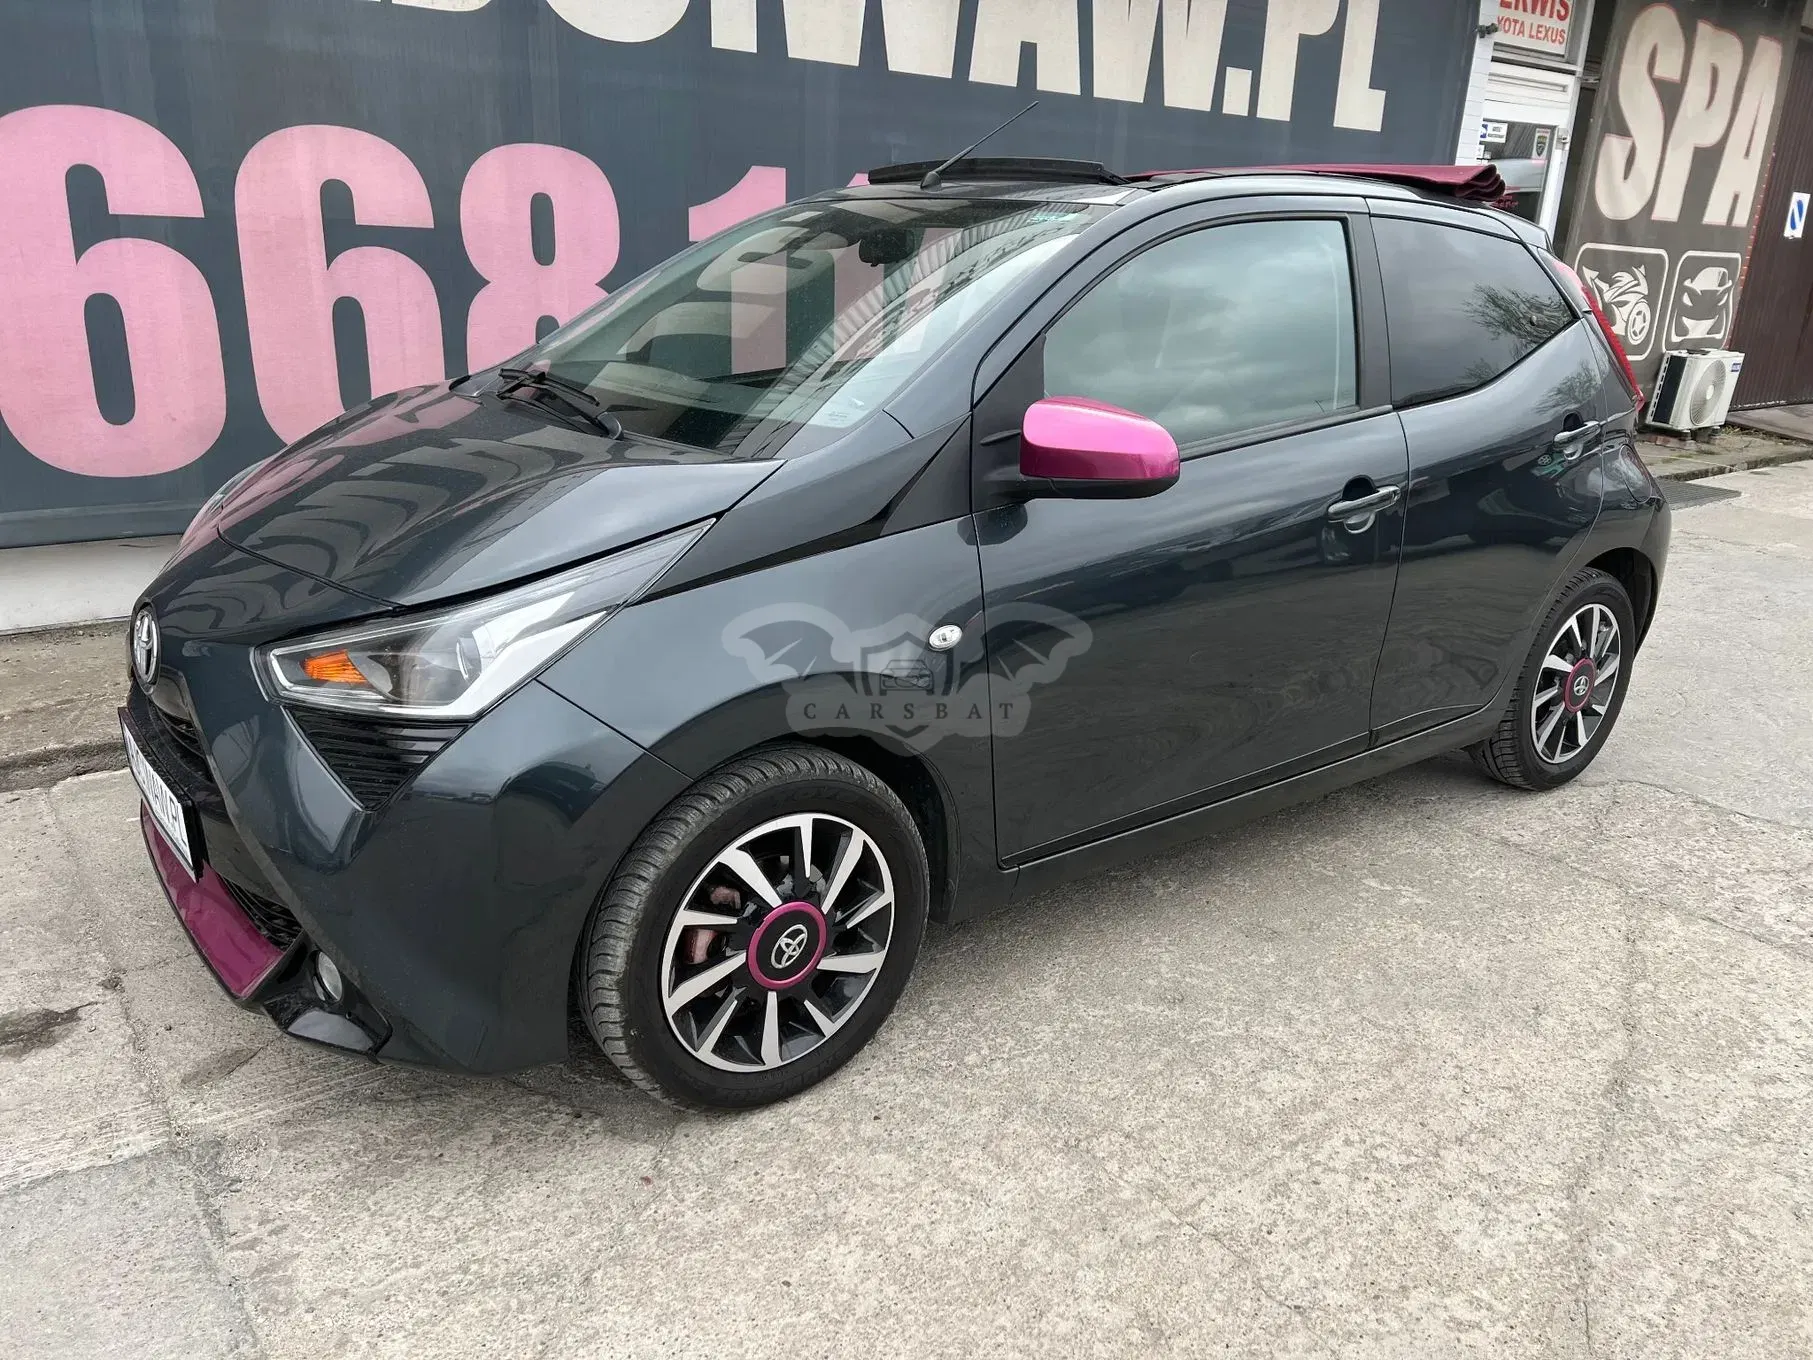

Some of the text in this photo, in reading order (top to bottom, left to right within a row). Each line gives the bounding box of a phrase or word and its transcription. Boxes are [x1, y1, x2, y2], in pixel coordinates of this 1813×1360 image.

[1529, 22, 1566, 45] LEXUS
[1595, 3, 1782, 227] SPA
[0, 104, 621, 478] 668
